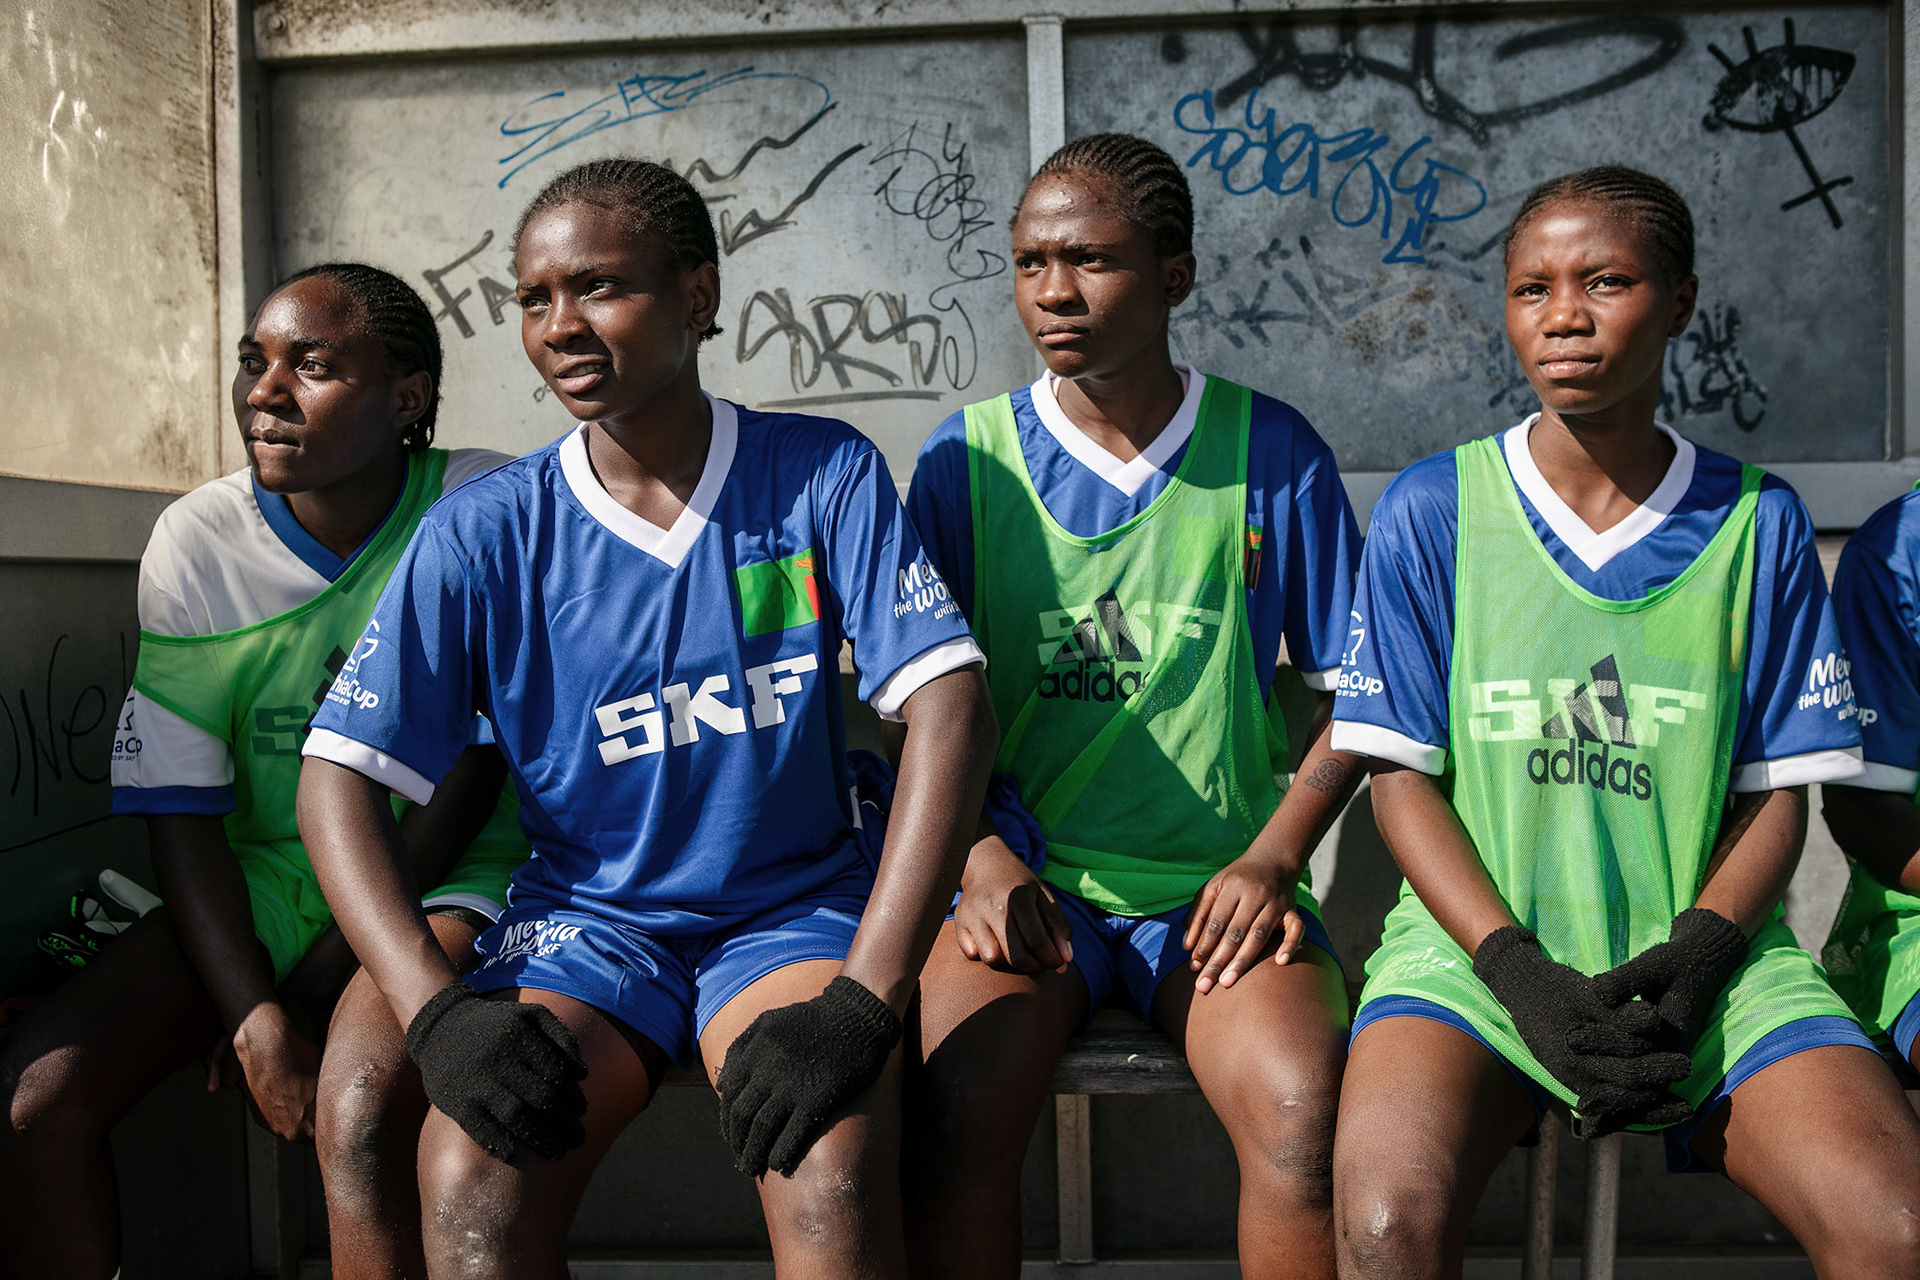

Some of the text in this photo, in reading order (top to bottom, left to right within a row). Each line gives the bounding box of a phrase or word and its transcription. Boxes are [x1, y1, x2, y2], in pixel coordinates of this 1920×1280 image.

[893, 600, 913, 619] the
[1037, 662, 1151, 702] adida
[1798, 679, 1855, 711] the wo
[594, 653, 819, 767] SKF
[1527, 738, 1652, 801] adidas
[534, 943, 562, 958] SKF
